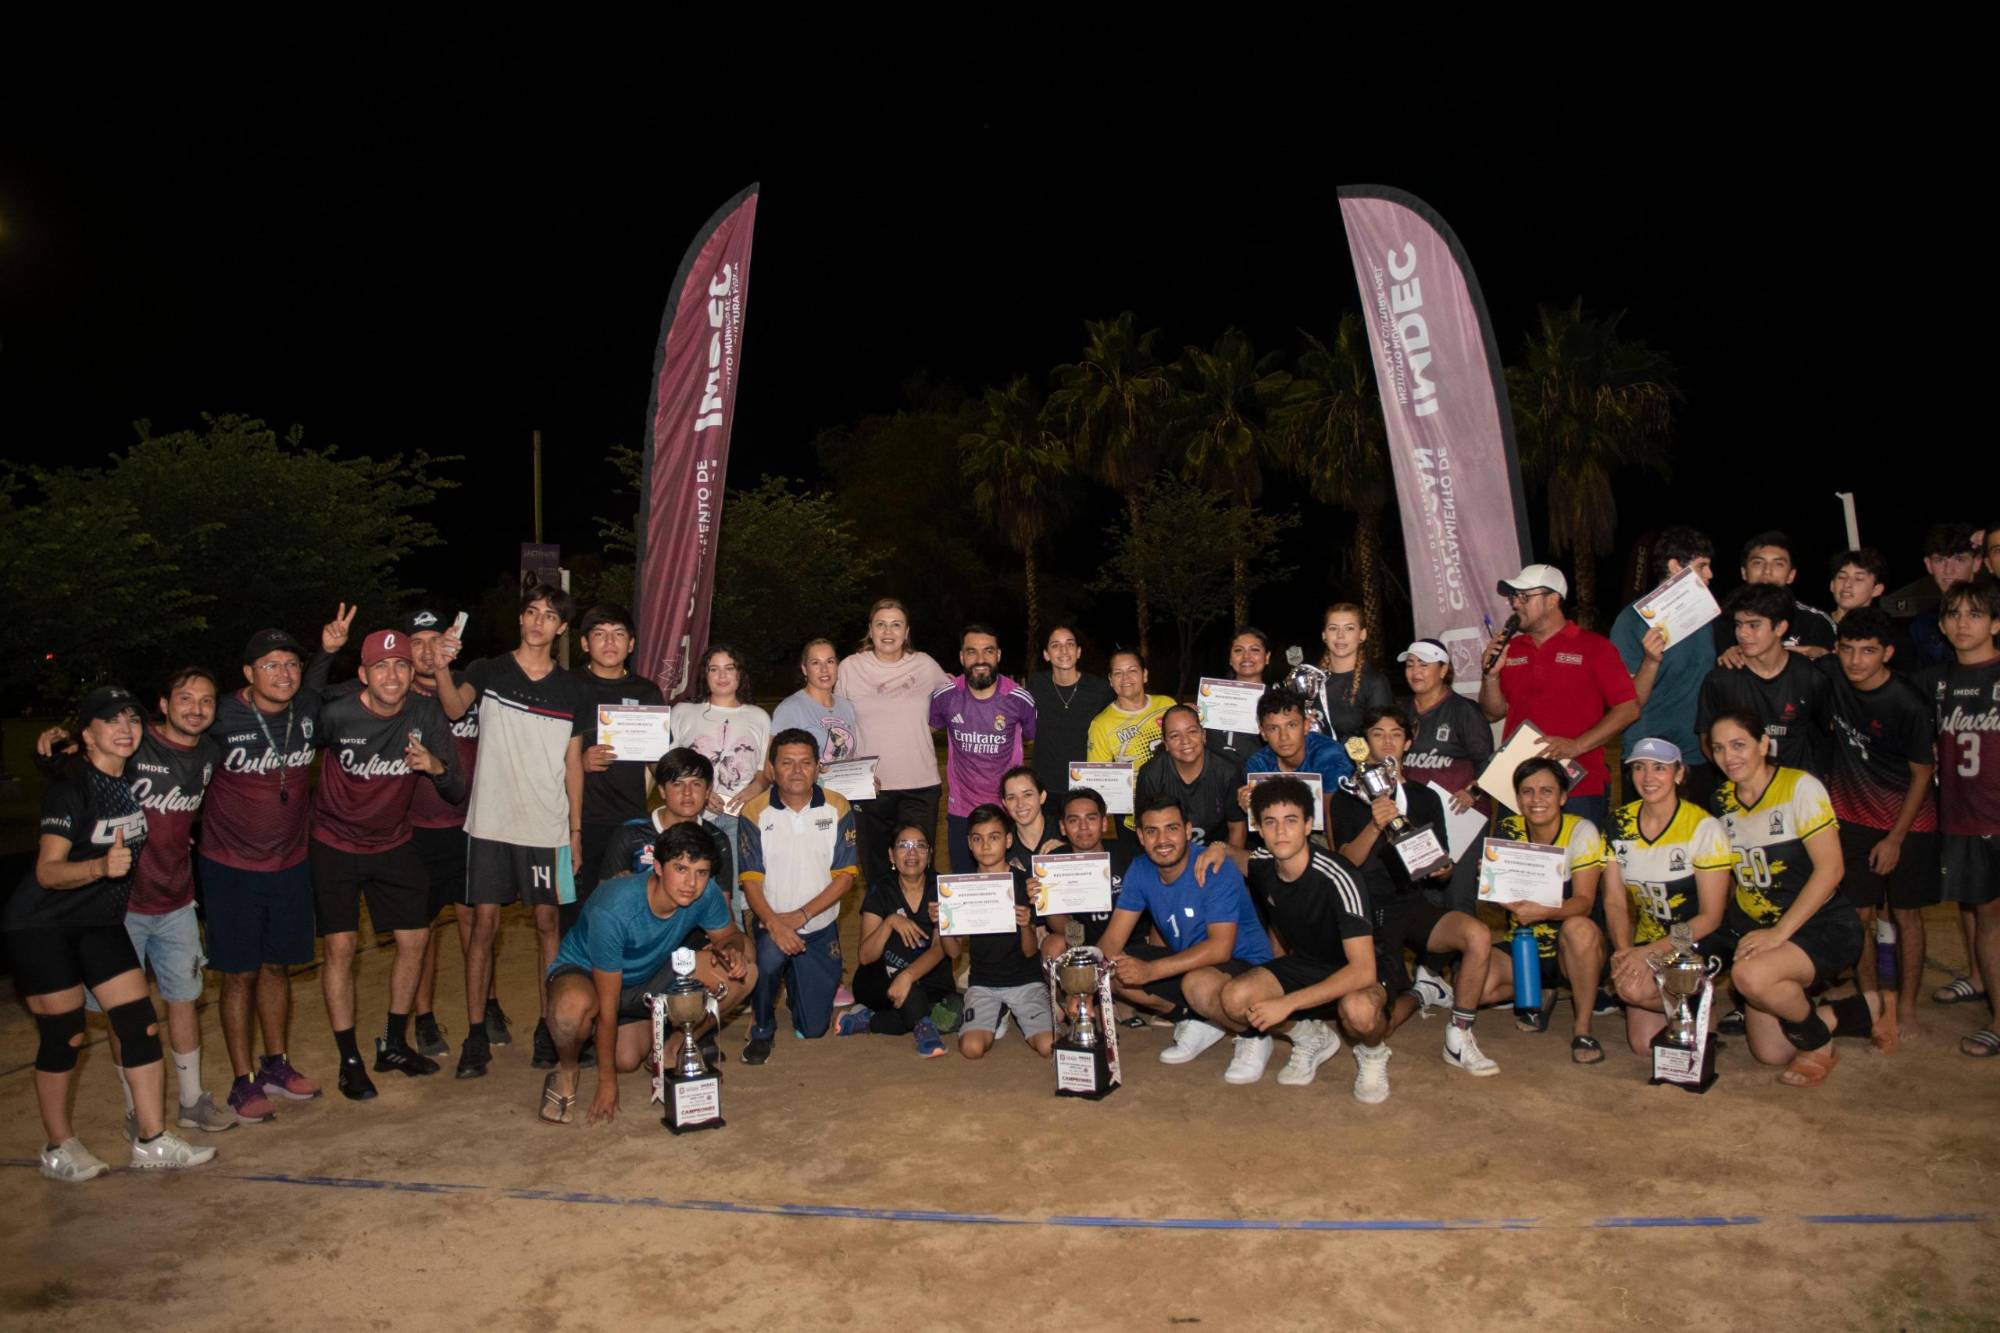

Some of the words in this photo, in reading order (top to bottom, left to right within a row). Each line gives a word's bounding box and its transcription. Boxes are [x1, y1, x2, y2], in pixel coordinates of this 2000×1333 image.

[696, 460, 709, 483] DE
[383, 634, 396, 650] C
[1953, 688, 1981, 696] IMDEC
[227, 732, 258, 744] IMDEC
[954, 729, 1007, 744] Emirates
[962, 742, 973, 752] FLY
[973, 743, 999, 754] BETTER
[1956, 731, 1981, 778] 3
[137, 762, 170, 774] IMDEC
[339, 748, 412, 780] Culiac
[531, 864, 551, 889] 14
[1732, 846, 1772, 888] 20
[1166, 913, 1180, 938] 1
